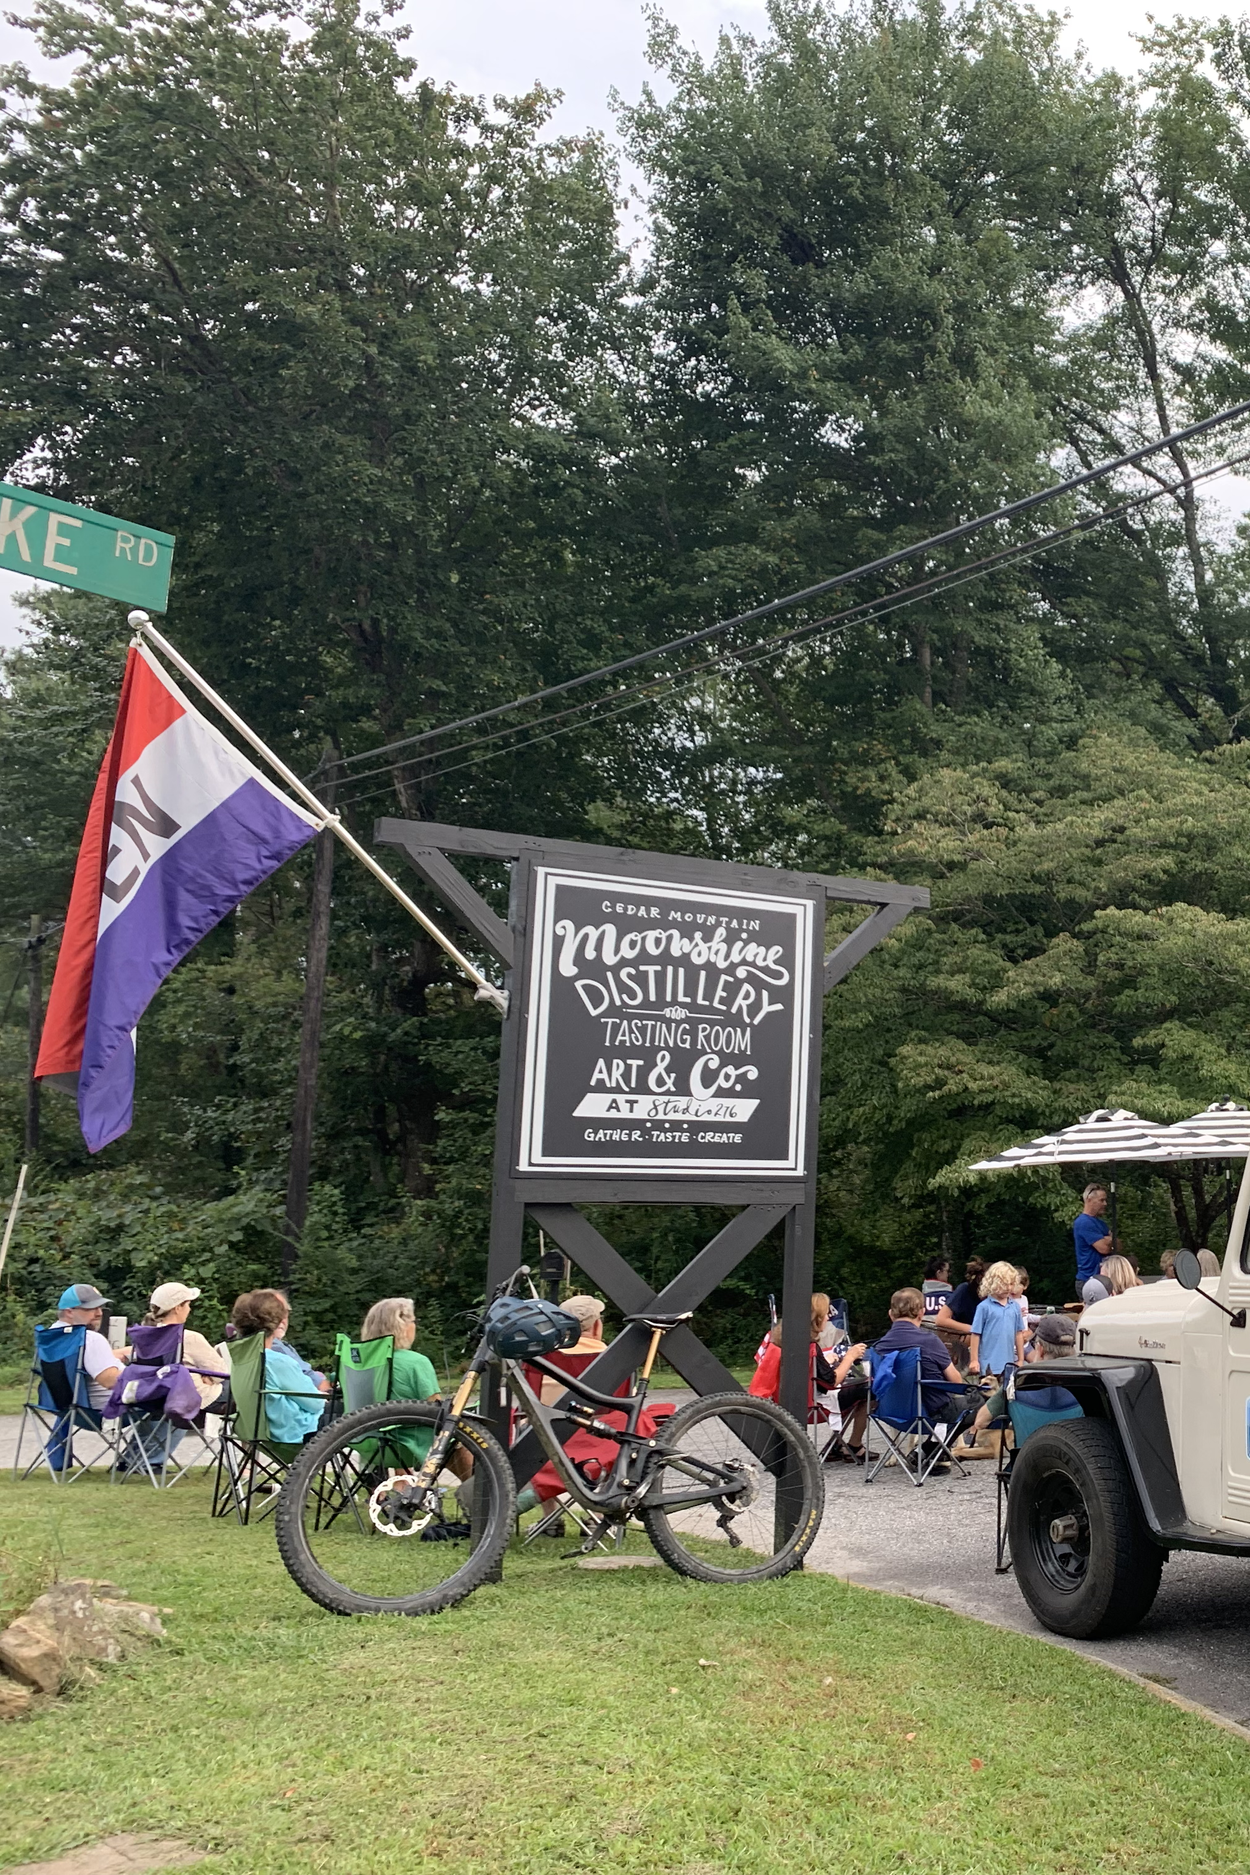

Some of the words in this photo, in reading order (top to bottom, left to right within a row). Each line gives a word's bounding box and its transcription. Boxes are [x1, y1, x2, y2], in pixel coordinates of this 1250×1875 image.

[114, 530, 158, 567] RD
[601, 900, 661, 918] CEDAR
[669, 910, 761, 931] MOUNTAIN
[554, 919, 790, 986] Moonshine
[574, 965, 785, 1026] DISTILLERY
[600, 1018, 691, 1048] TASTING
[697, 1023, 751, 1054] ROOM
[590, 1058, 645, 1091] ART
[648, 1051, 677, 1093] &
[605, 1098, 639, 1113] AT
[584, 1128, 643, 1142] GATHER
[651, 1130, 690, 1143] TASTE
[697, 1131, 743, 1143] CREATE
